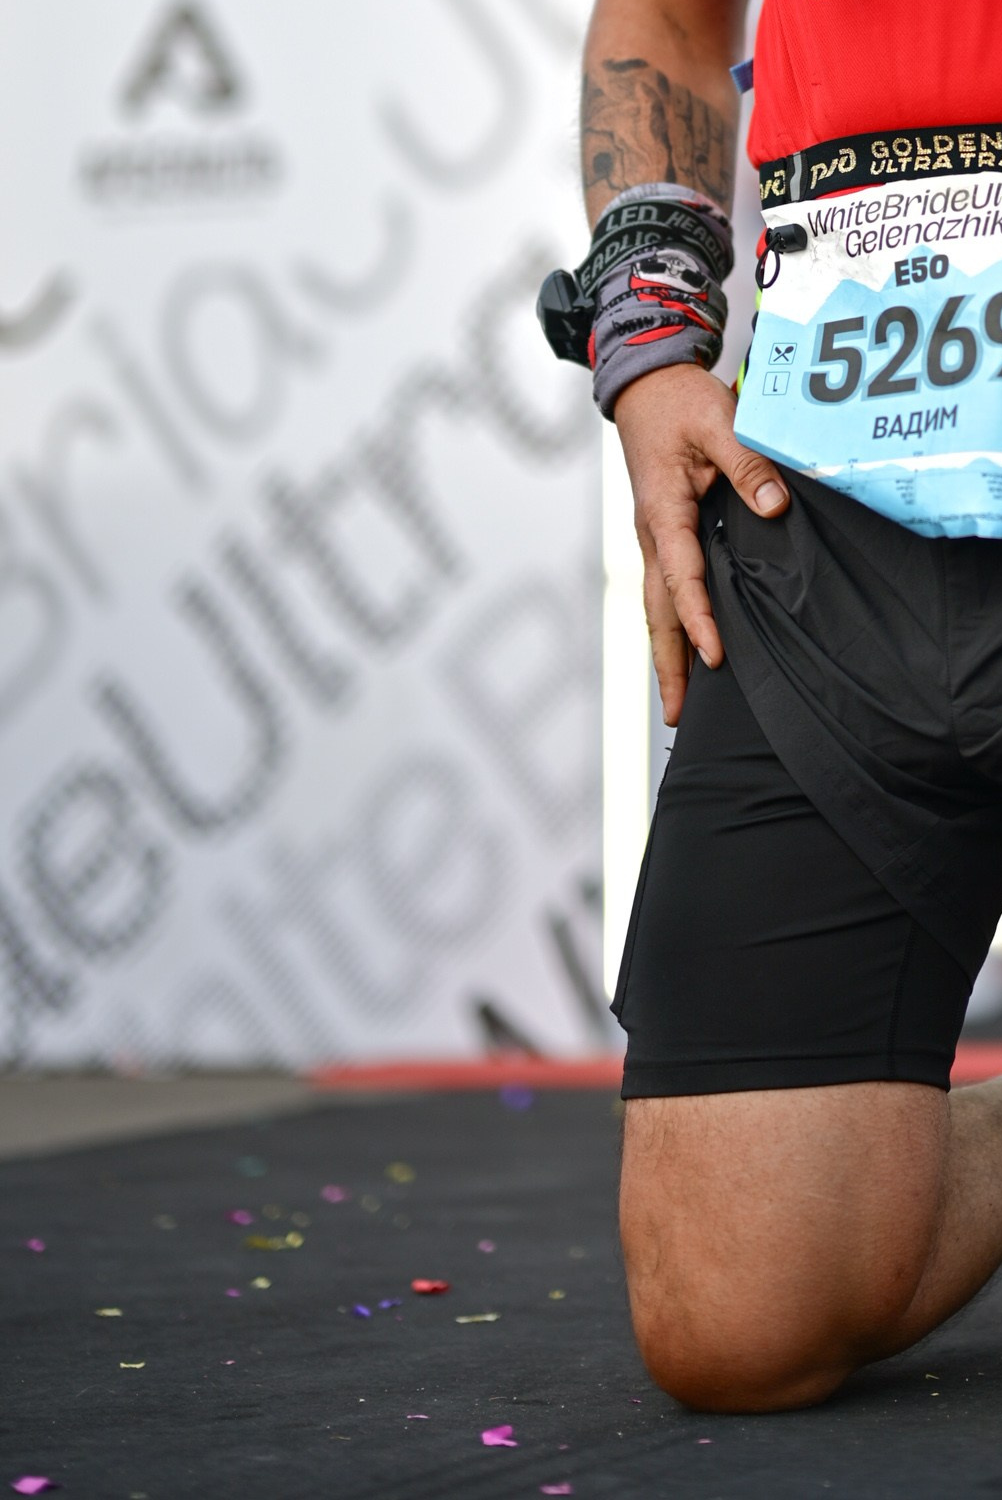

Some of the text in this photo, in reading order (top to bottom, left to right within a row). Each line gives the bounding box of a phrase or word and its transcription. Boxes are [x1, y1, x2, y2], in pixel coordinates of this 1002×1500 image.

[871, 131, 1002, 159] GOLDEN
[869, 152, 953, 176] ULTRA
[894, 254, 949, 287] E50
[771, 375, 778, 393] L
[872, 404, 958, 440] ВАДИМ
